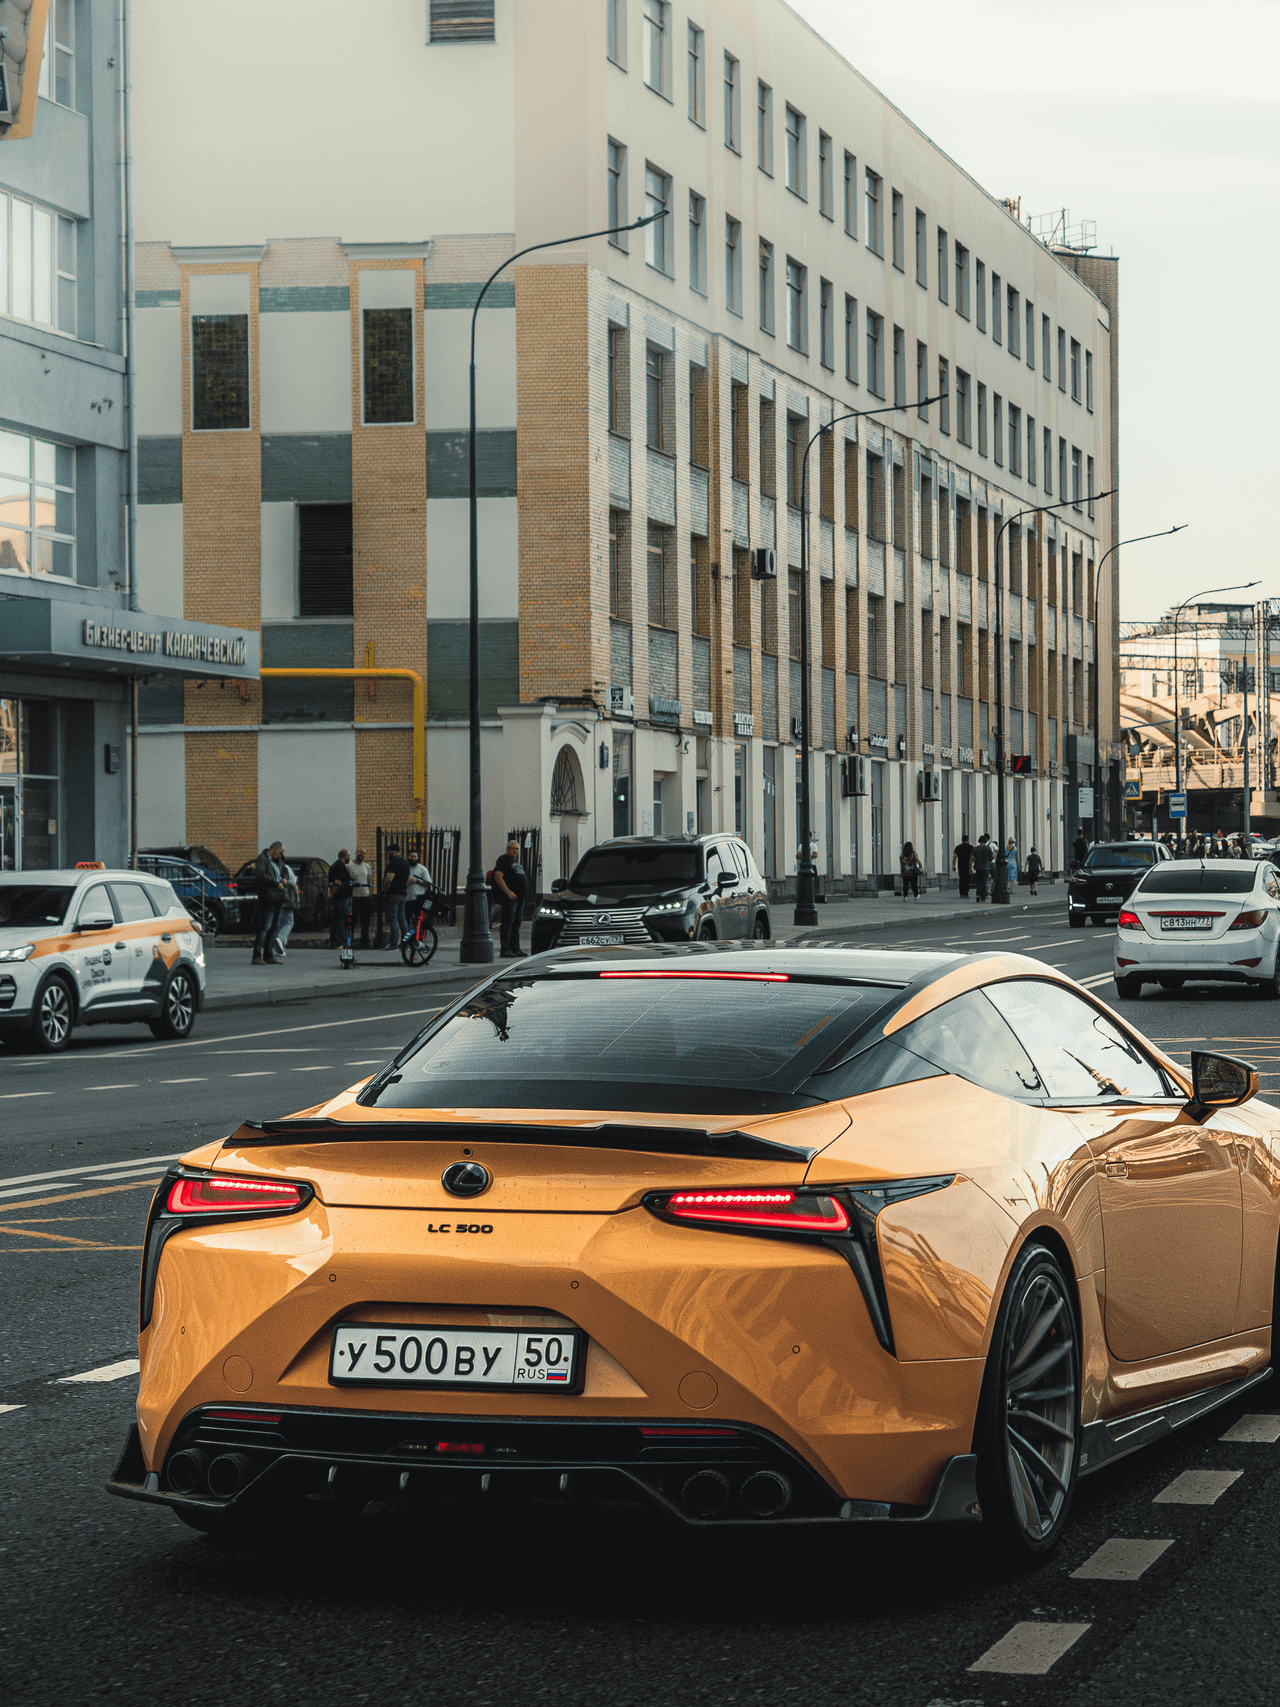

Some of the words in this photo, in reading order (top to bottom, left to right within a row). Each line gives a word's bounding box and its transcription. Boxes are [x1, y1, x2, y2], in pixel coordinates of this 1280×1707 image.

[427, 1223, 451, 1233] LC
[455, 1223, 494, 1234] 500
[347, 1335, 502, 1376] У500ВУ
[524, 1337, 563, 1367] 50
[516, 1368, 546, 1380] RUS
